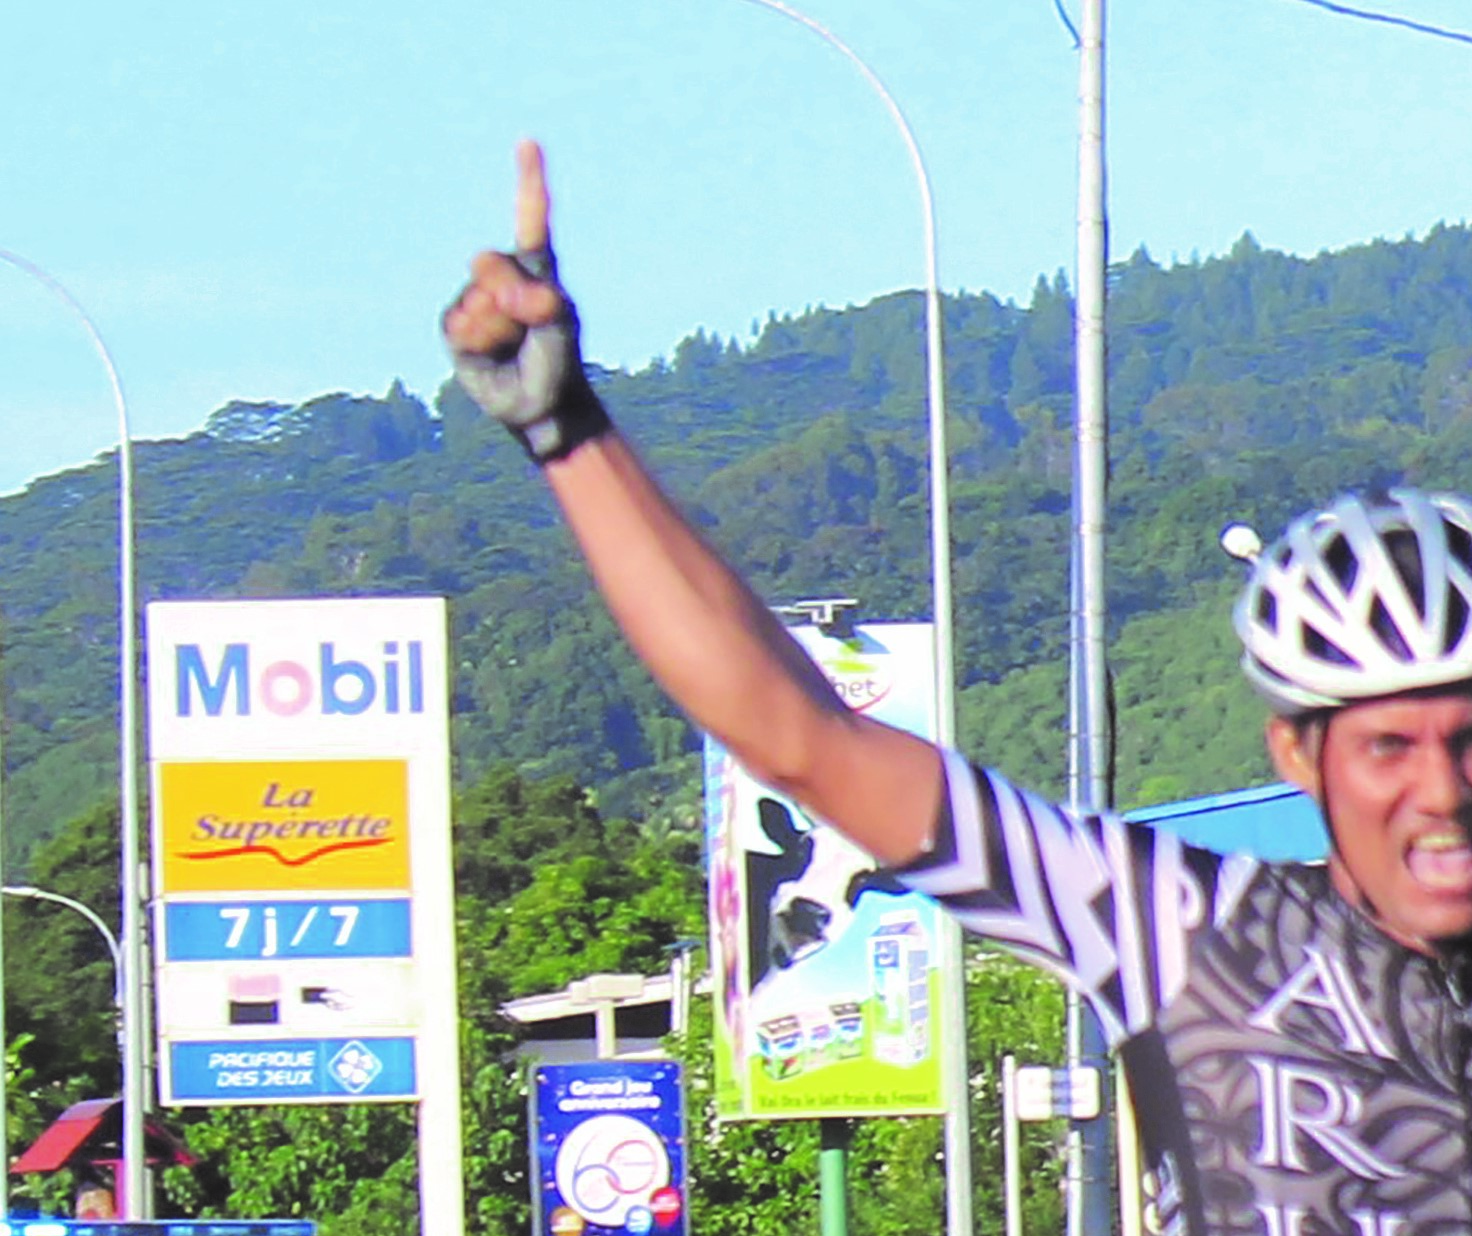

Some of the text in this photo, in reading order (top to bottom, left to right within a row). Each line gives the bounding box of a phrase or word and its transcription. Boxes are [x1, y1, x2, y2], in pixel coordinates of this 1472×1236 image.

[174, 641, 424, 718] Mobil
[262, 781, 316, 808] La
[208, 1051, 316, 1070] PACIFIQUE
[216, 1068, 315, 1088] DES JEUX
